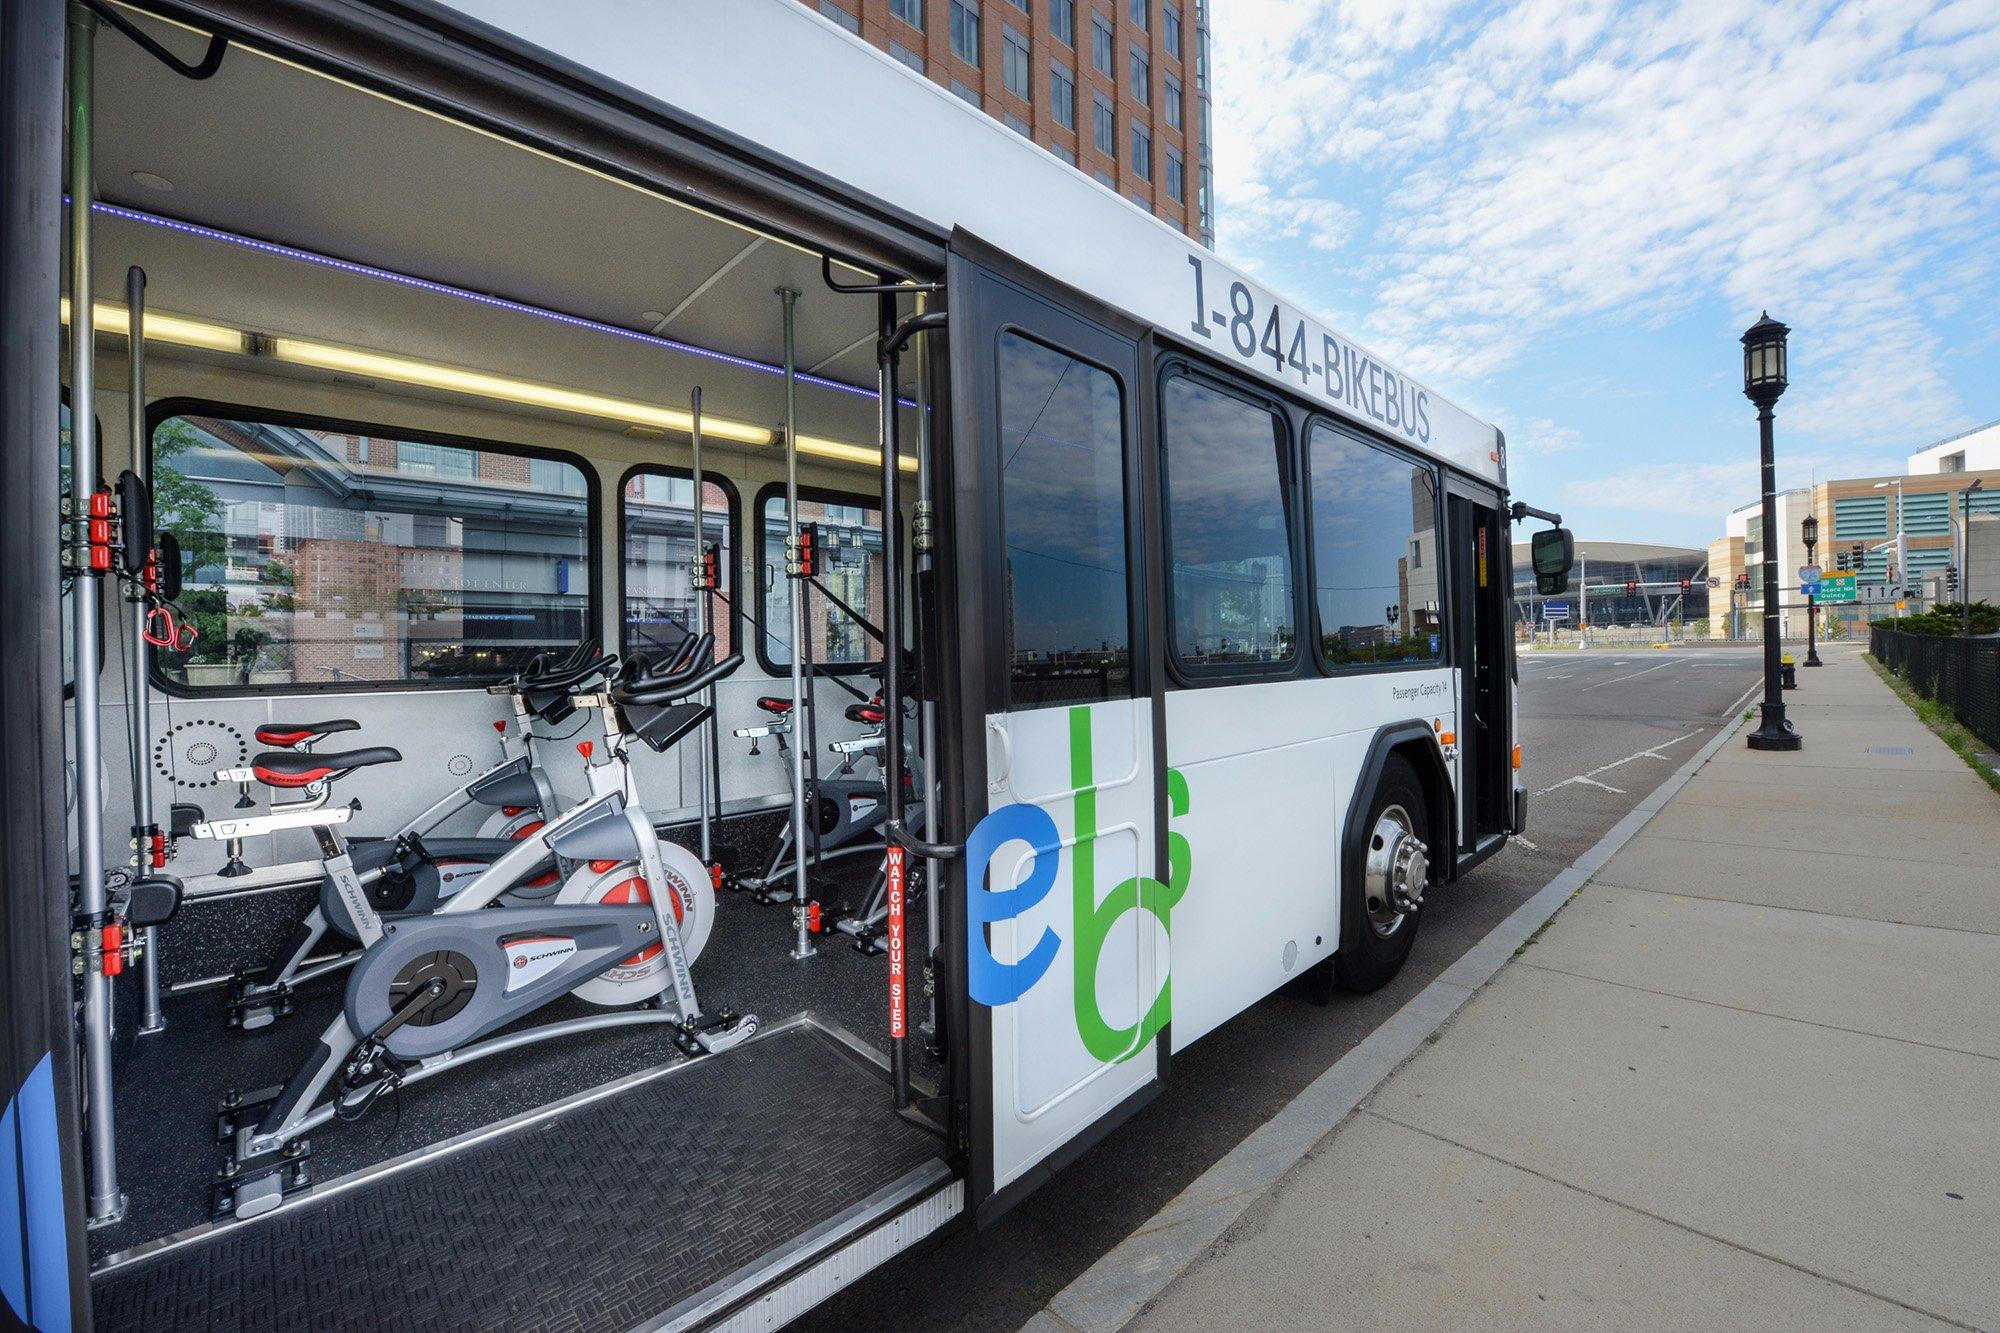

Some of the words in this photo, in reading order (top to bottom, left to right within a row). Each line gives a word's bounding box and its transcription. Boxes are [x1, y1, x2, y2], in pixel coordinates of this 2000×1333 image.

[1188, 254, 1430, 444] 1-844-BIKEBUS
[484, 580, 528, 591] ENTER
[1392, 687, 1419, 701] Passenger
[1420, 683, 1441, 699] Capacity
[266, 774, 311, 783] SCHWINN
[340, 874, 371, 930] SCHWINN
[664, 869, 694, 912] WINN
[889, 853, 902, 916] WATCH
[529, 947, 574, 962] SCHWINN
[662, 912, 692, 1000] SCHWINN
[891, 924, 902, 975] YOUR
[892, 983, 902, 1033] STEP
